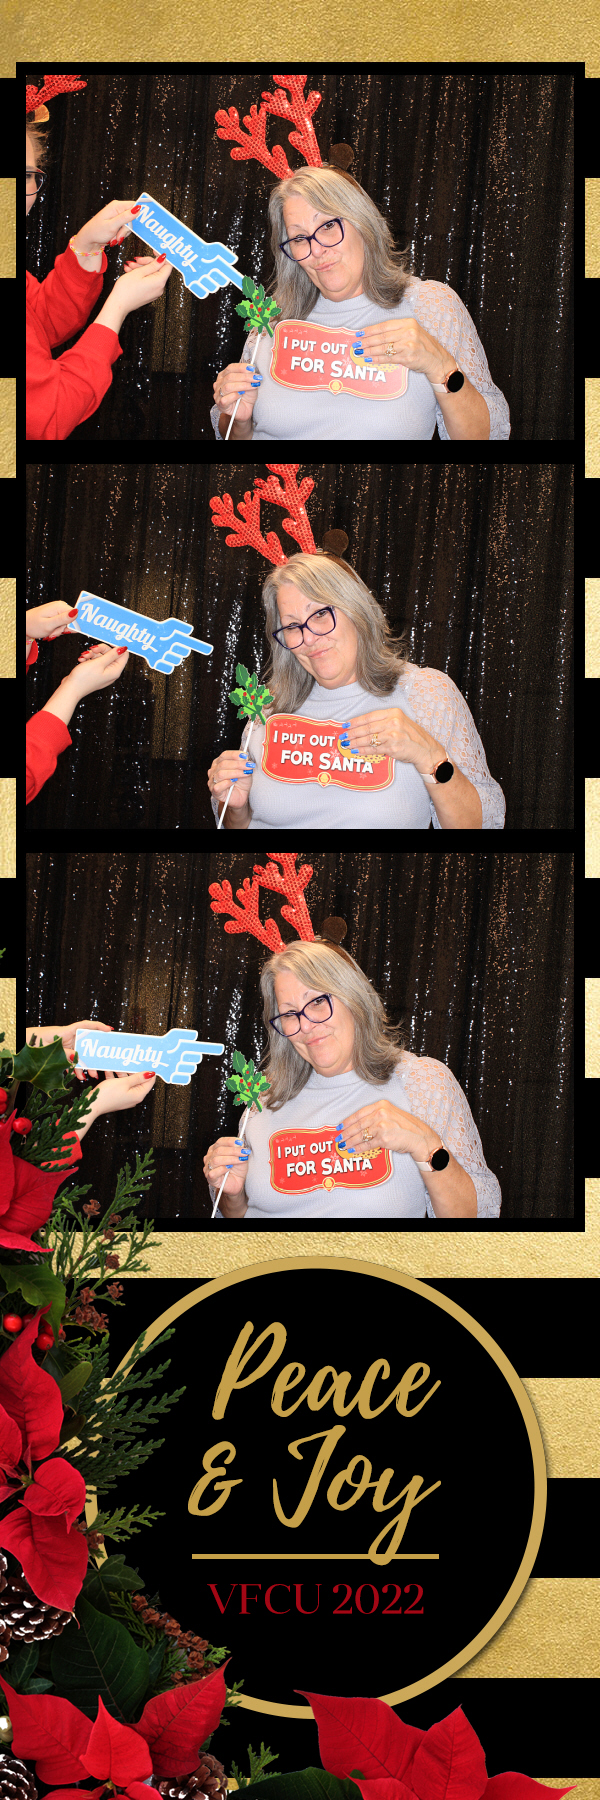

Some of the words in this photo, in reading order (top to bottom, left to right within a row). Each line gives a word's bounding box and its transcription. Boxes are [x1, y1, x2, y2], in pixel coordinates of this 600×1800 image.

[136, 204, 199, 273] Naughty
[283, 336, 288, 349] I
[291, 338, 317, 352] PUT
[320, 341, 348, 355] OUT
[290, 356, 325, 374] FOR
[330, 360, 387, 383] SANTA
[80, 603, 158, 653] Naughty
[273, 730, 278, 743] I
[281, 732, 306, 745] PUT
[309, 734, 336, 747] OUT
[280, 749, 313, 767] FOR
[319, 752, 374, 774] SANTA
[80, 1038, 169, 1069] Naughty
[277, 1146, 281, 1159] I
[284, 1144, 306, 1158] PUT
[309, 1140, 333, 1154] OUT
[286, 1160, 317, 1177] FOR
[321, 1157, 373, 1176] SANTA
